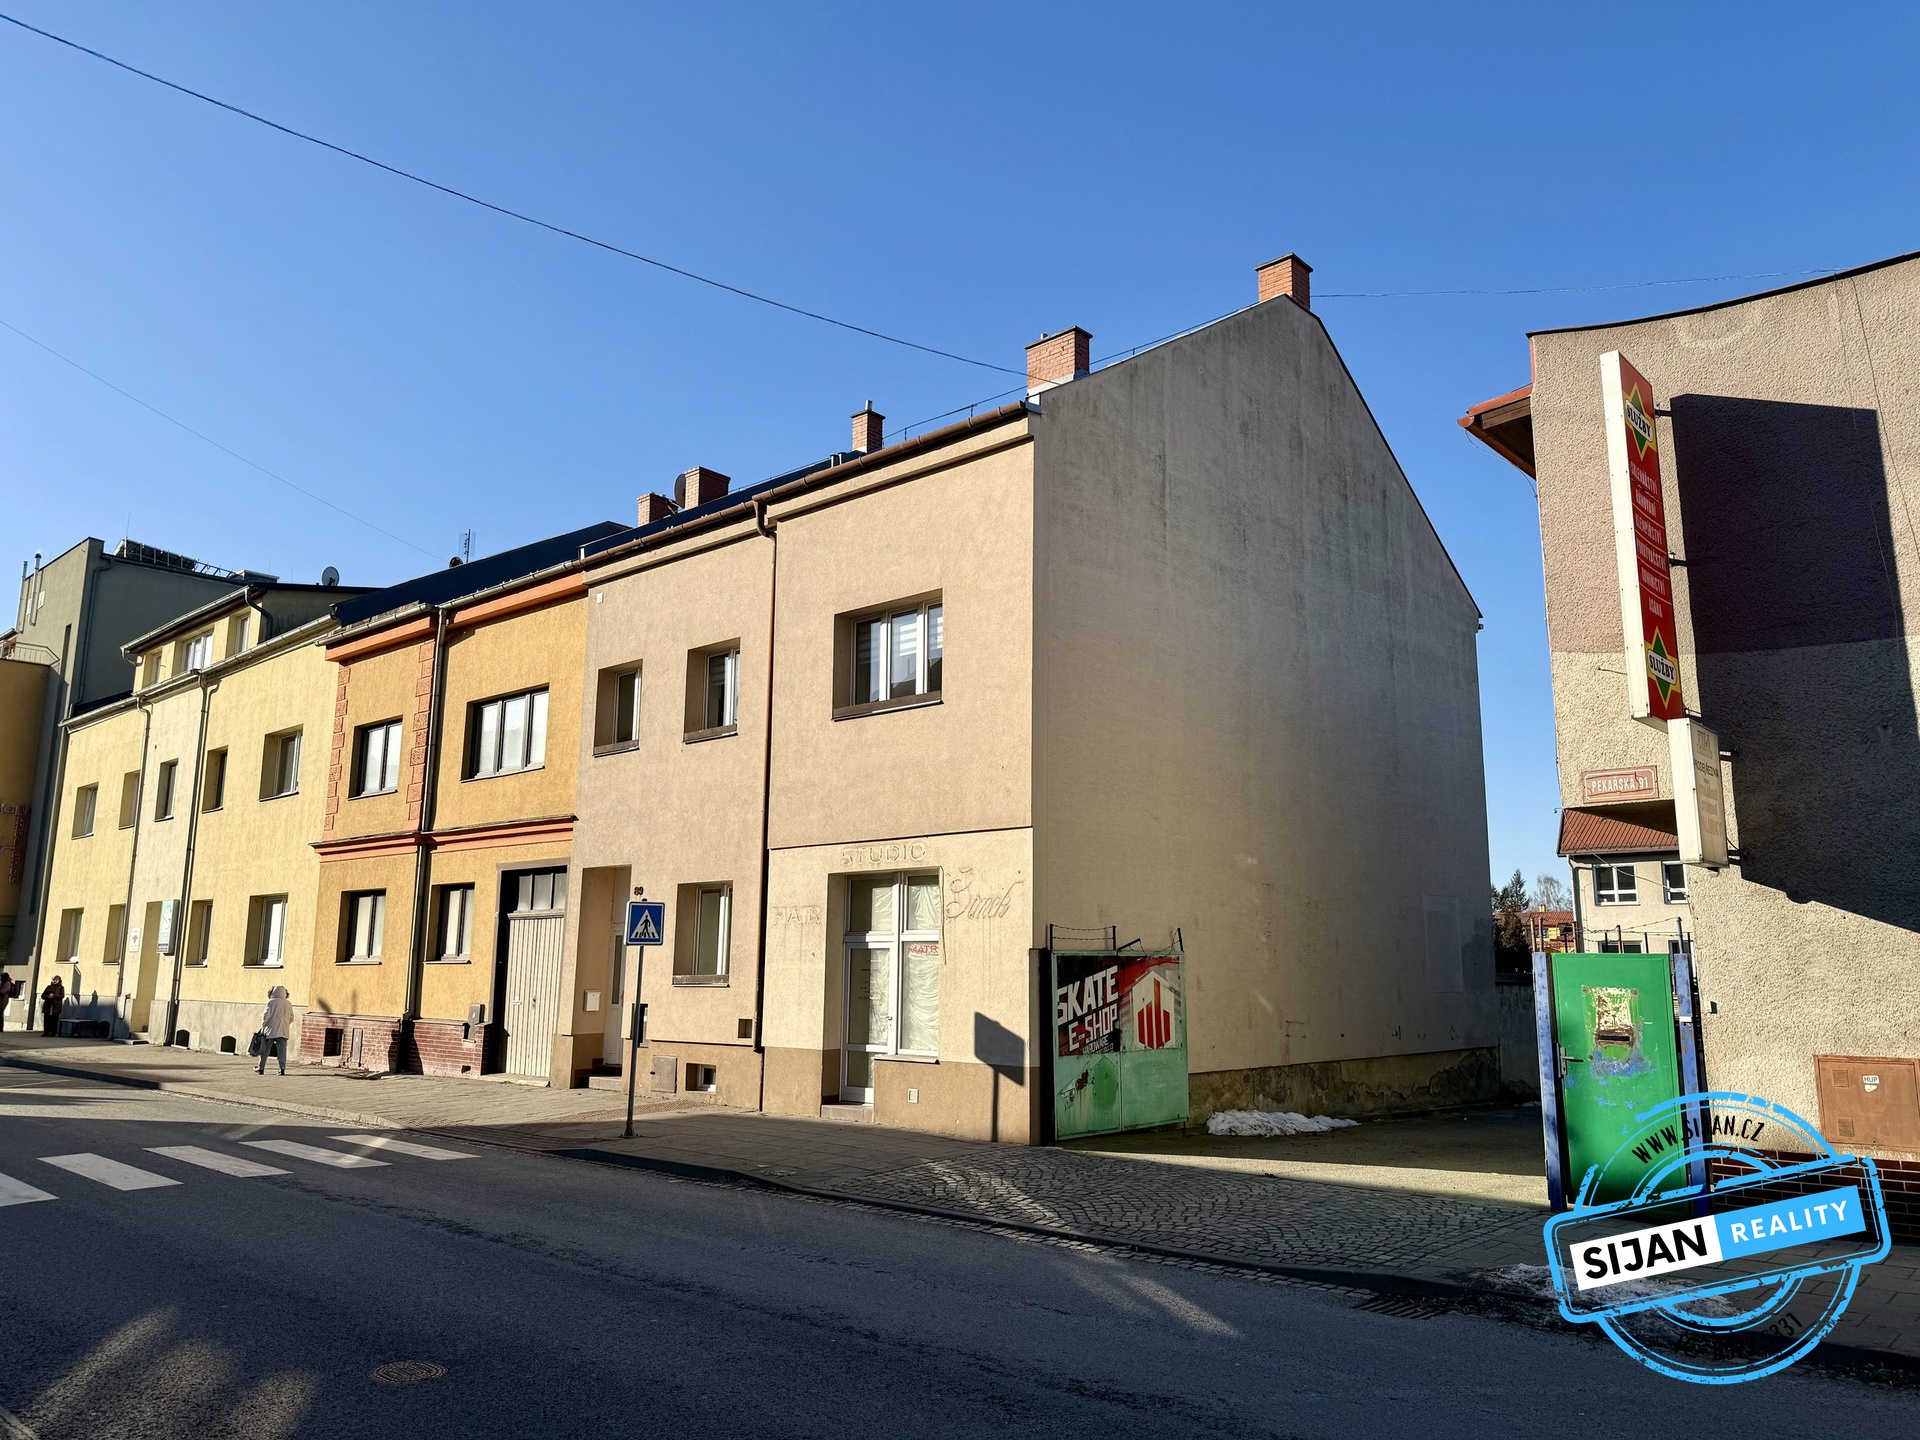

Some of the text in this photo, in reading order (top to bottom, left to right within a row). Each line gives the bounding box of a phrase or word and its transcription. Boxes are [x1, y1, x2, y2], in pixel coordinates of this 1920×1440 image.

[1626, 404, 1651, 438] SLUŽBY
[1648, 653, 1676, 681] SLUŽBY
[1591, 775, 1649, 793] PEKAŘSKÁ 91
[840, 842, 928, 866] STUDIO
[908, 944, 939, 955] MATR
[1057, 965, 1119, 1027] SKATE
[1068, 1003, 1118, 1052] E-SHOP
